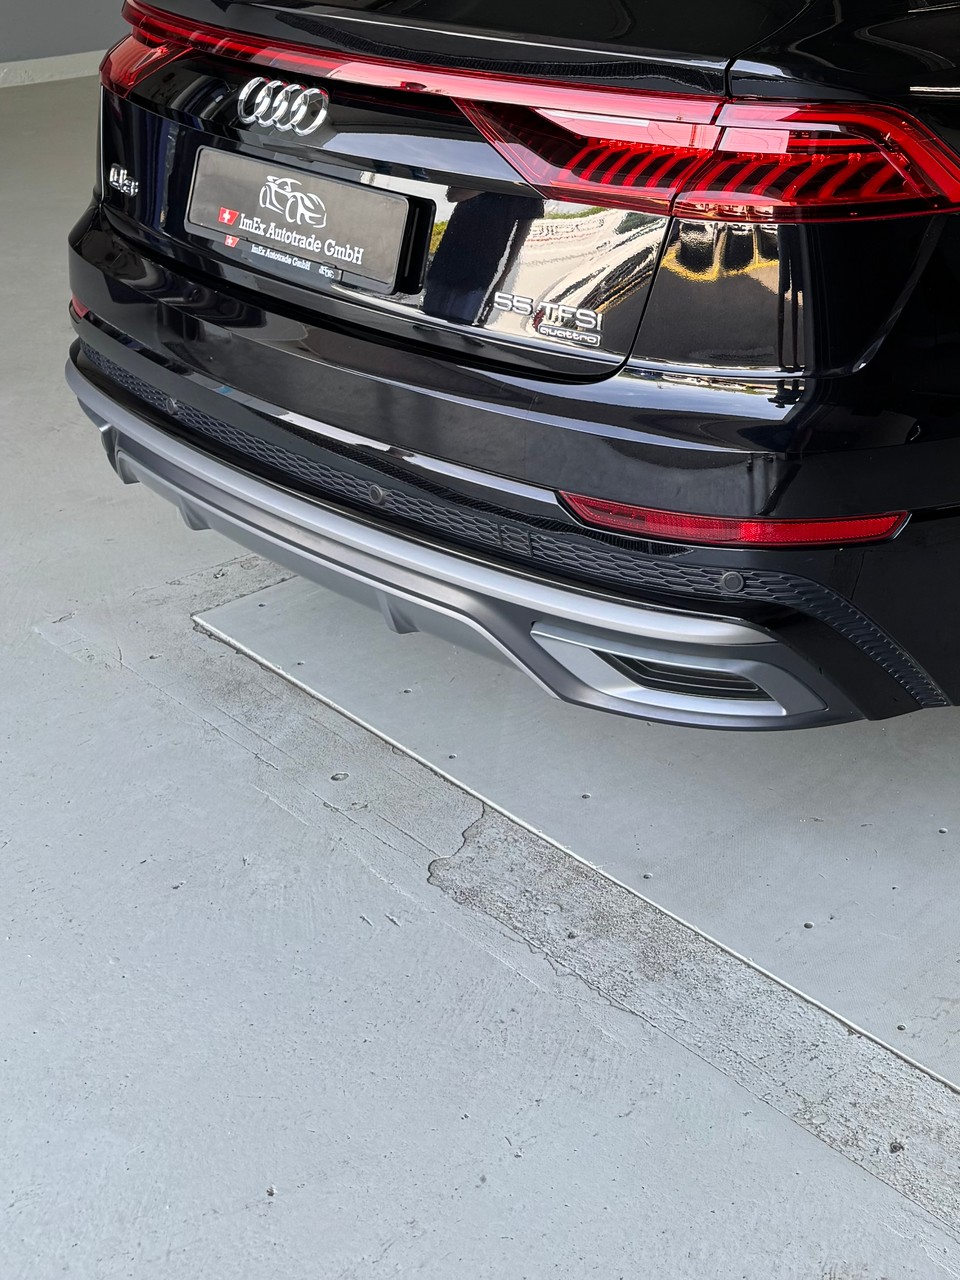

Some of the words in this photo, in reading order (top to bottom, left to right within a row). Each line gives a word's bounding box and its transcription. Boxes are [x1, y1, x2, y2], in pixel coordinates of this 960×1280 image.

[238, 213, 265, 235] ImEx
[266, 222, 322, 252] Autotrade
[324, 241, 365, 265] GmbH
[251, 244, 266, 255] ImEx
[266, 249, 292, 265] Autotrade
[292, 258, 311, 271] GmbH
[494, 291, 534, 316] 55
[540, 301, 603, 331] TFSI
[539, 326, 598, 344] quattro
